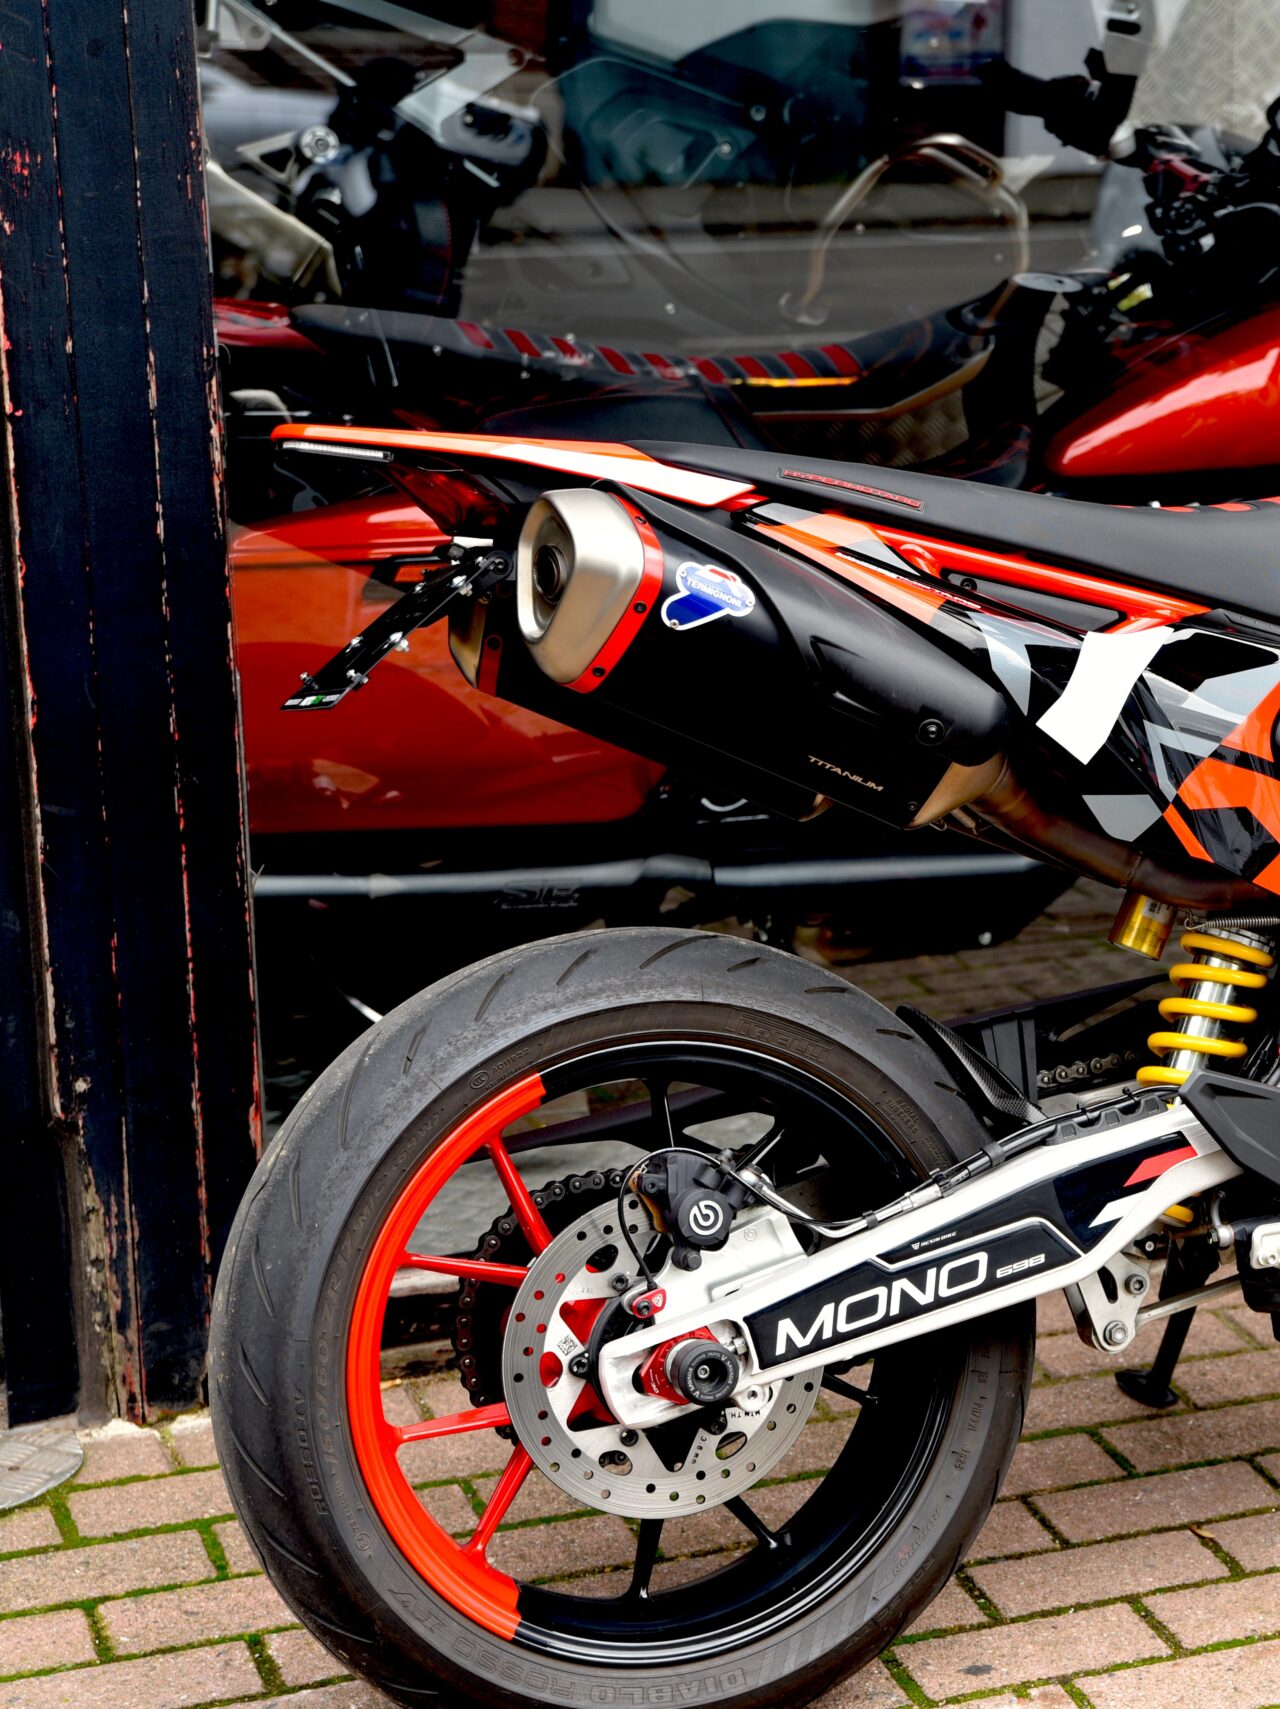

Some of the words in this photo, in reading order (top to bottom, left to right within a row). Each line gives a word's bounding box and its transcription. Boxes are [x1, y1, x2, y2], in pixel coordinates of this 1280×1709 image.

[686, 577, 743, 608] TERMIGNONI
[808, 754, 884, 791] TITANIUM
[775, 1251, 988, 1355] MONO
[996, 1253, 1046, 1278] 698
[385, 1588, 447, 1635] IV
[450, 1635, 576, 1699] ROSSO
[588, 1667, 748, 1705] DIABLO
